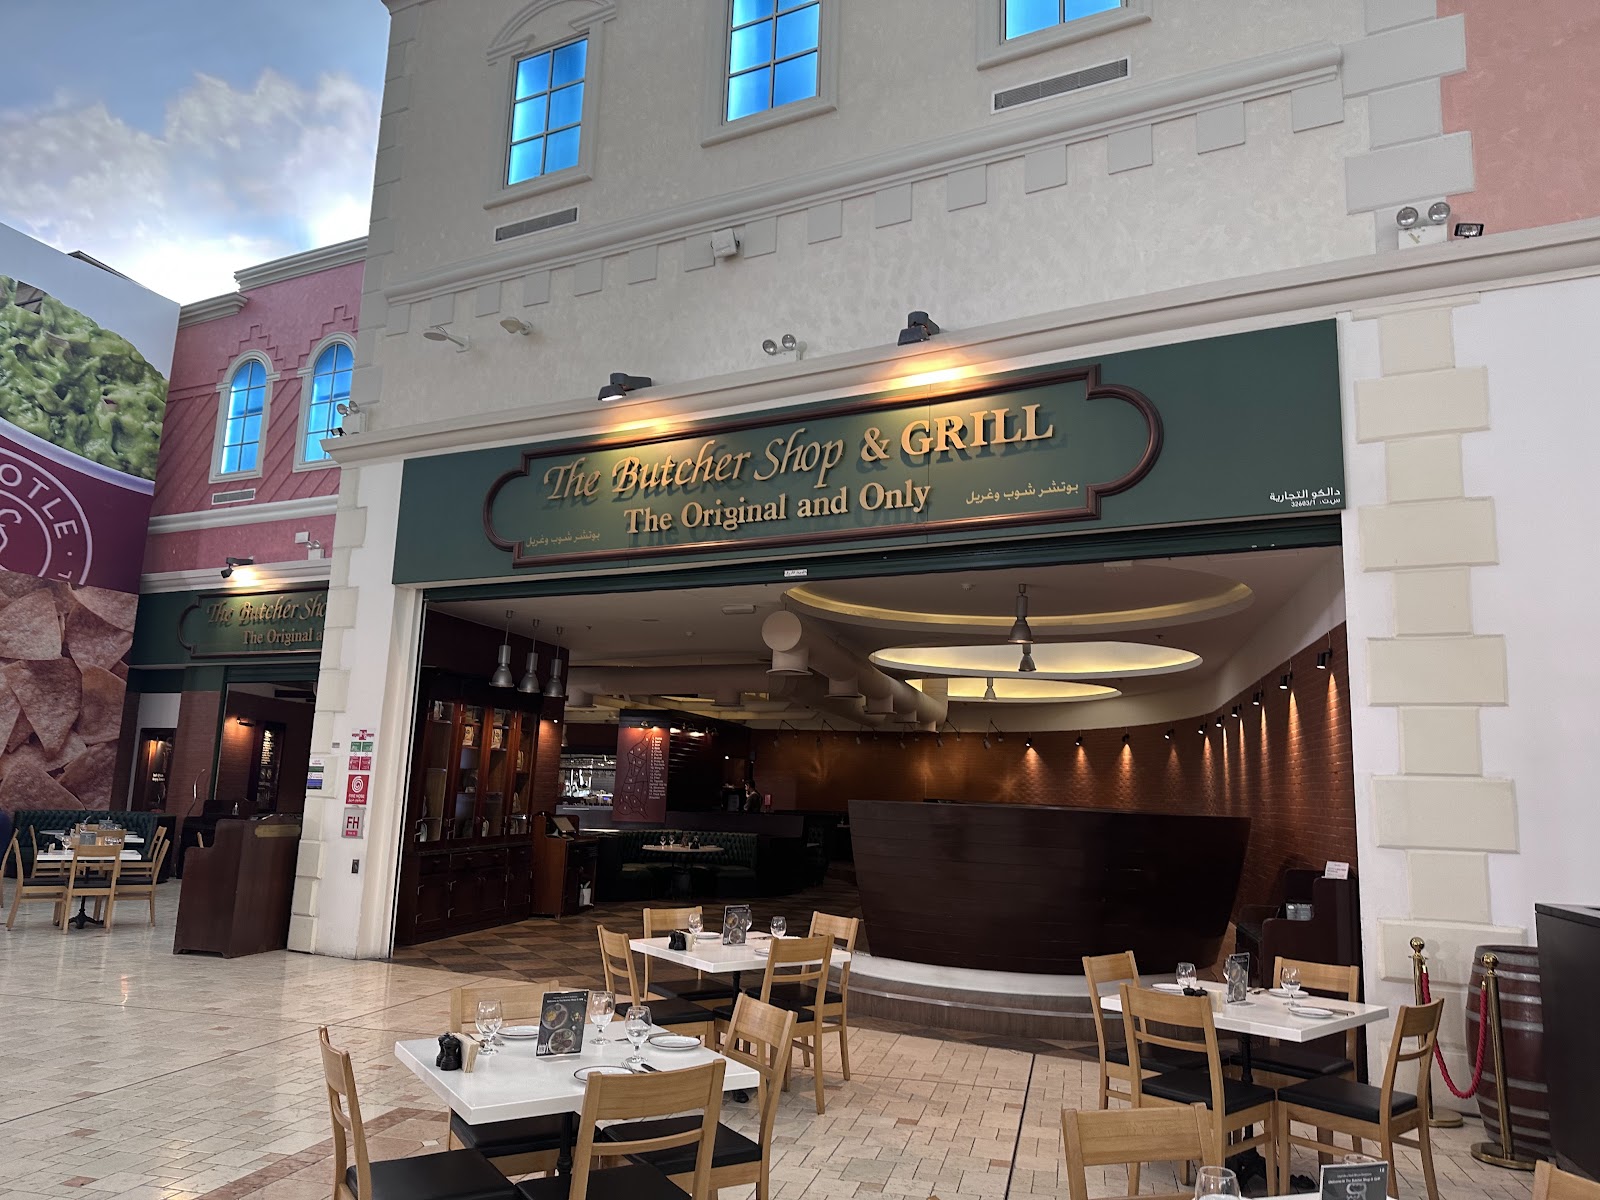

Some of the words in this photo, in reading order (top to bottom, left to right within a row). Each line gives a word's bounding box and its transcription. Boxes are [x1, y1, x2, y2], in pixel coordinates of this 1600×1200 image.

[543, 457, 601, 499] The
[612, 439, 751, 492] Butcher
[754, 428, 844, 489] Shop
[860, 427, 890, 462] &
[901, 403, 1054, 455] GRILL
[966, 488, 1000, 504] وغريل
[1003, 483, 1036, 500] شوب
[1038, 480, 1079, 497] بوتشر
[1269, 489, 1308, 502] التجارية
[1311, 487, 1340, 499] دالكو
[623, 507, 673, 534] The
[681, 493, 786, 530] Original
[797, 486, 848, 518] and
[859, 479, 931, 513] Only
[207, 601, 234, 622] The
[239, 596, 299, 621] Butcher
[244, 629, 263, 645] The
[266, 627, 313, 646] Original
[346, 816, 360, 829] FH
